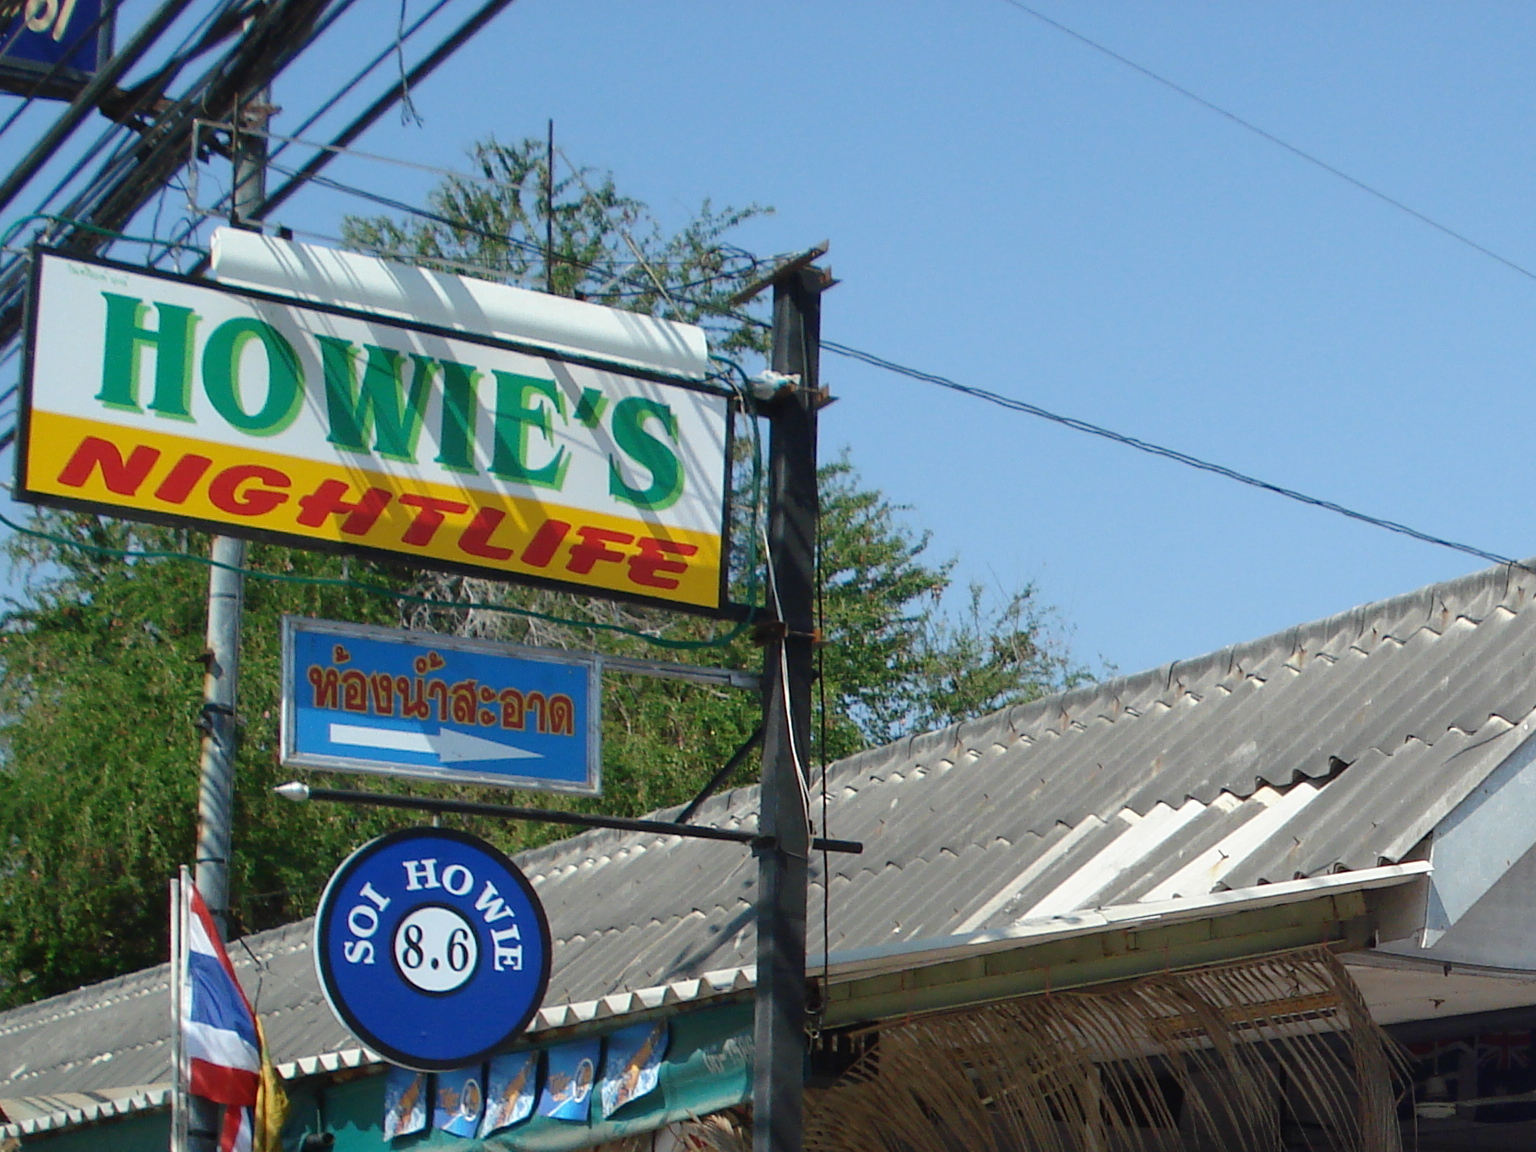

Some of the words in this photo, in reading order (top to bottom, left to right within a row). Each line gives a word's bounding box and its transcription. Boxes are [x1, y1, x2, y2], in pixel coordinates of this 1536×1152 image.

[94, 291, 686, 512] HOWIE'S
[57, 436, 698, 590] NIGHTLIFE
[307, 643, 575, 738] ห้องน้ำสะอาด
[343, 882, 391, 965] SOI
[402, 858, 522, 972] HOWIE
[402, 924, 469, 972] 8.6
